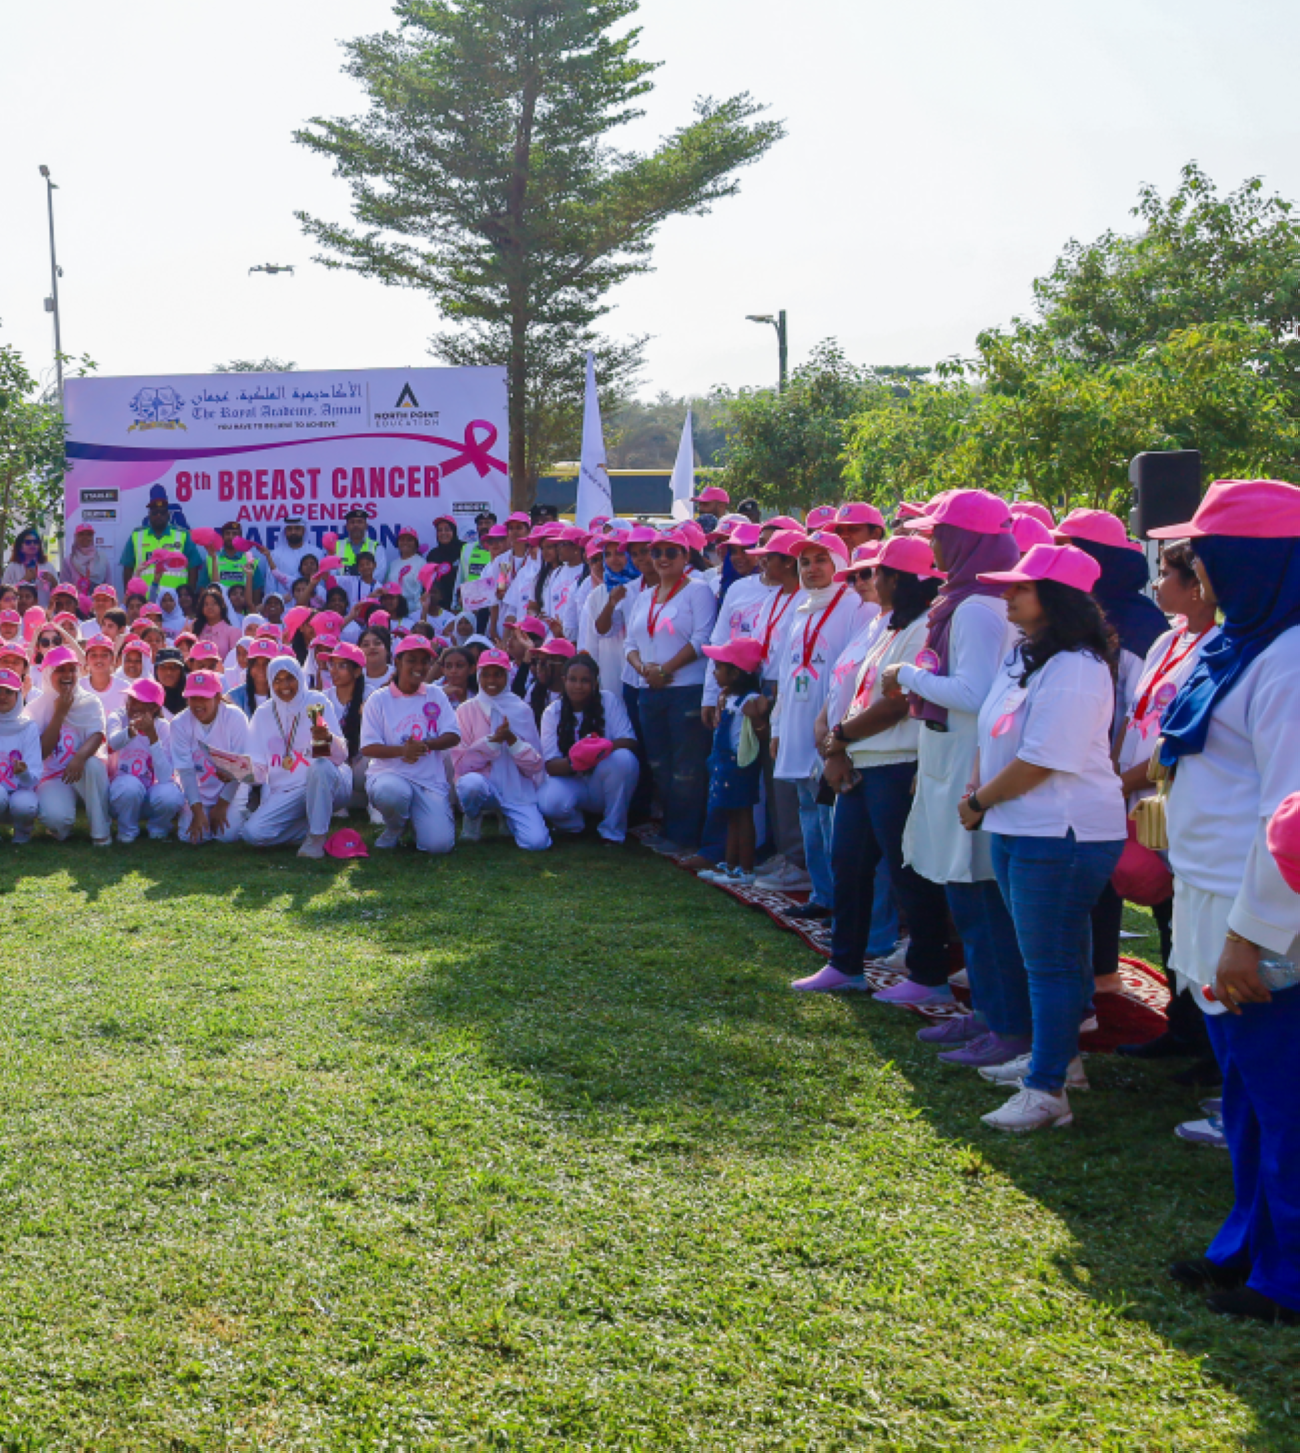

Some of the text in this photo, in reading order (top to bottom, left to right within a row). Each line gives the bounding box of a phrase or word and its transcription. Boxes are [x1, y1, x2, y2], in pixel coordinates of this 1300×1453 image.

[192, 406, 216, 420] The
[220, 406, 257, 420] Royal
[321, 403, 362, 418] Ajman
[374, 410, 440, 420] NORTH POINT
[175, 465, 441, 502] 8th BREAST CANCER
